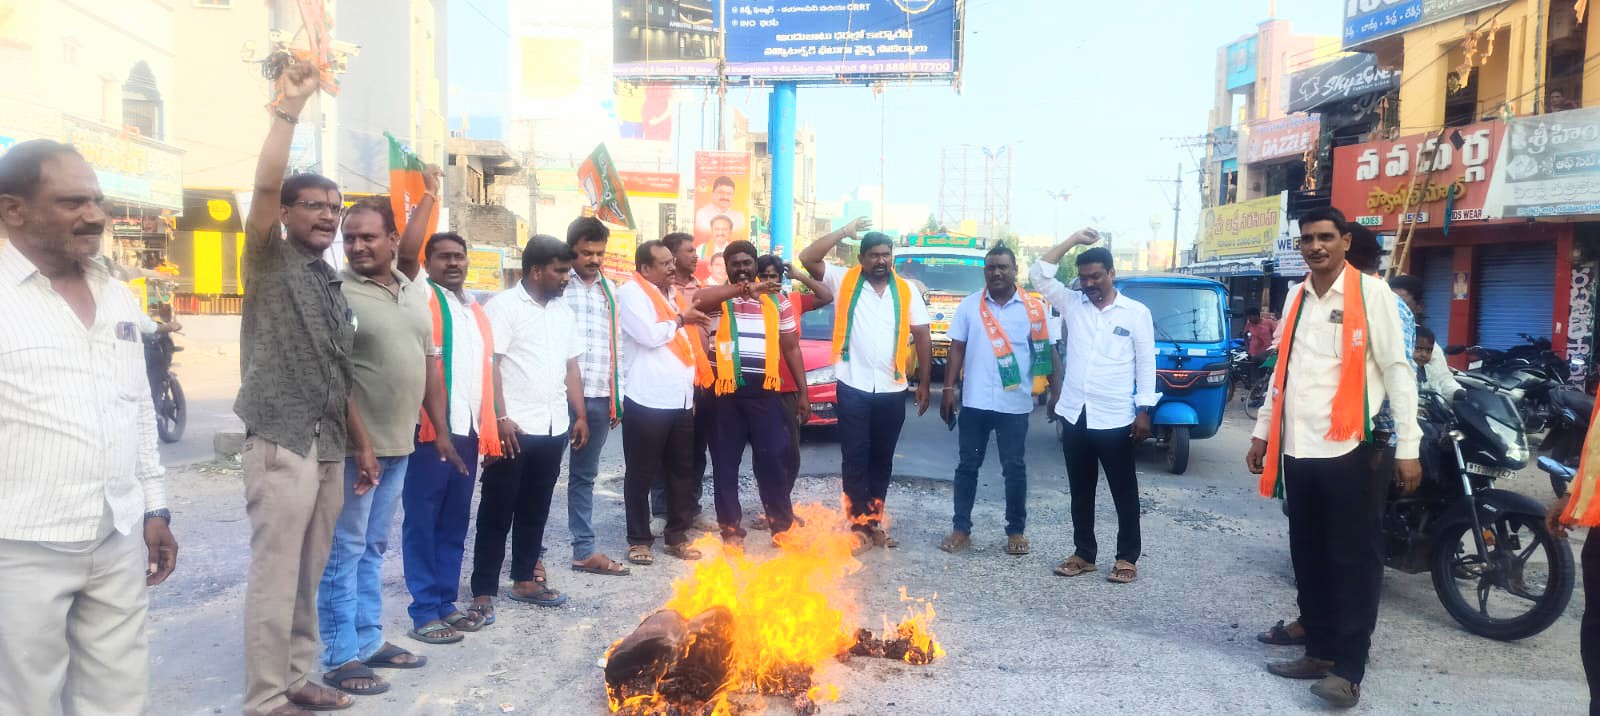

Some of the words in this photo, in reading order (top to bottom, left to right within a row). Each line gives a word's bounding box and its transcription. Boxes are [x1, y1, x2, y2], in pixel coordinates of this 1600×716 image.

[920, 60, 950, 71] 17700
[1527, 122, 1548, 154] శ్రీ
[1463, 208, 1483, 219] WEAR
[1278, 239, 1292, 250] WE
